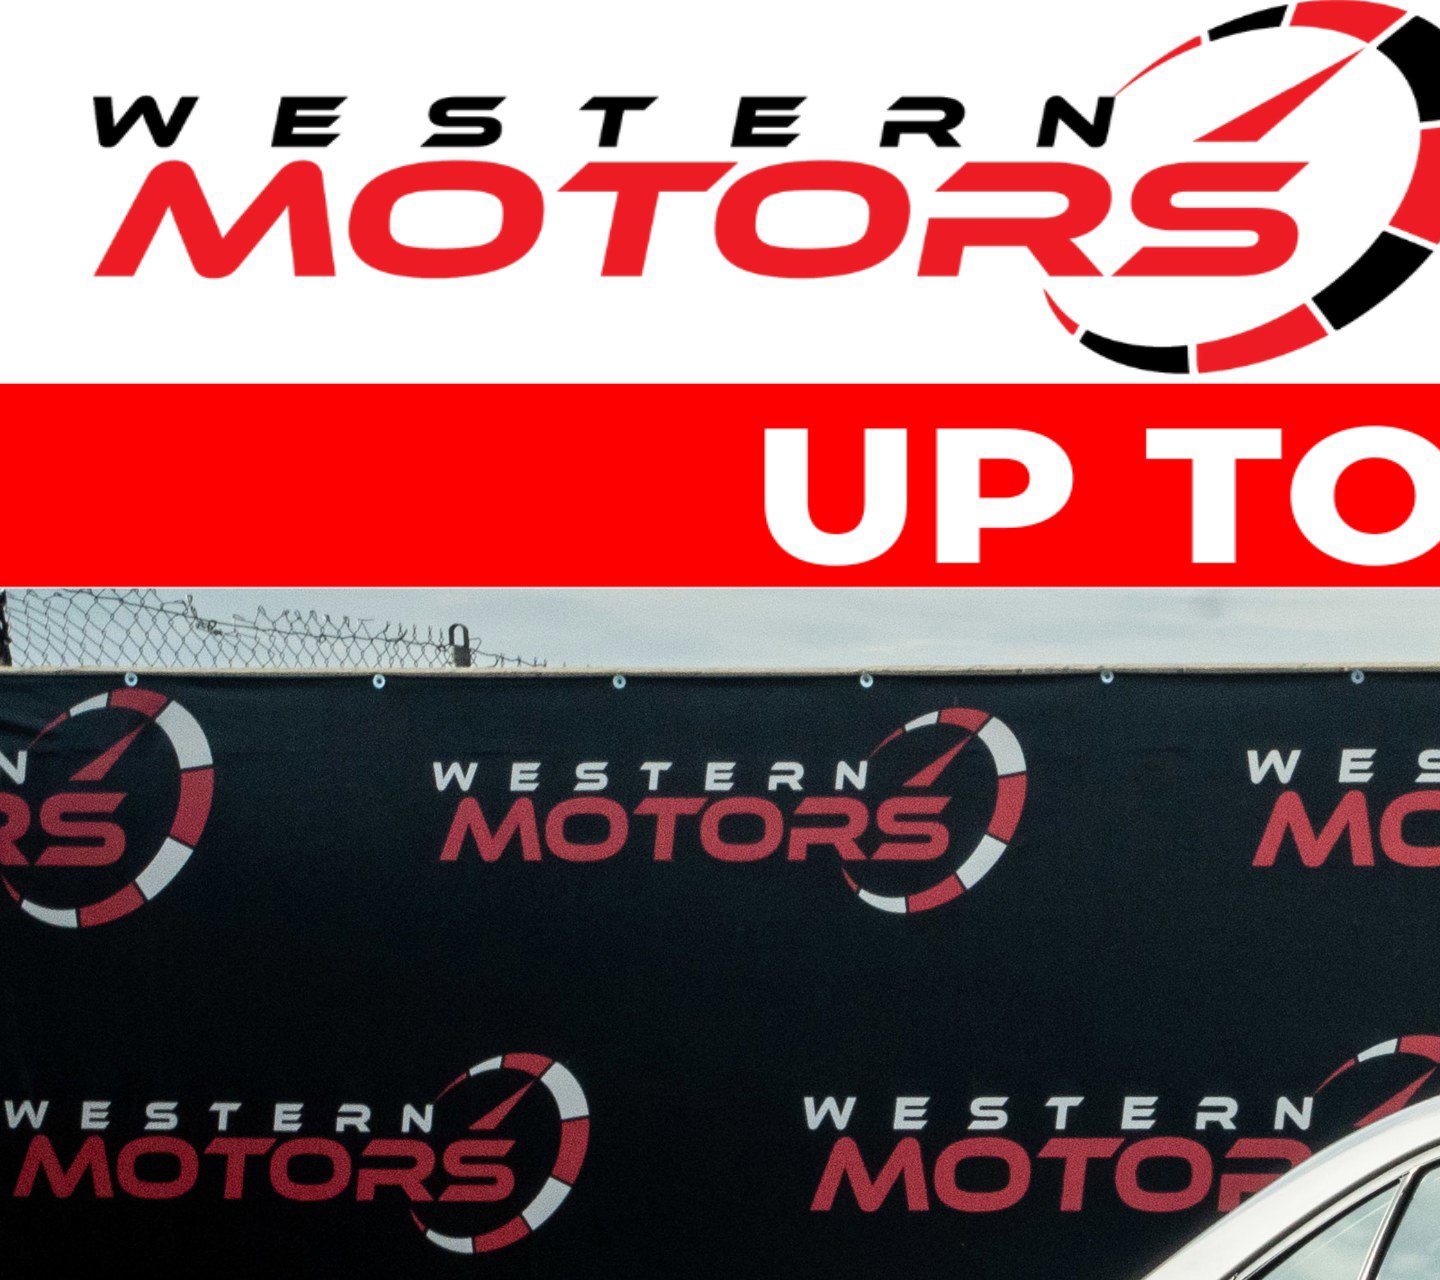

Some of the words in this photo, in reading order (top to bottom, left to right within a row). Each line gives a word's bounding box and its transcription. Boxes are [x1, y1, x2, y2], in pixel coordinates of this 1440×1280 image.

[433, 761, 867, 791] WESTERN
[440, 796, 952, 862] MOTORS
[5, 1101, 433, 1132] WESTERN
[804, 1097, 1313, 1130] WESTERN
[13, 1135, 517, 1200] MOTORS
[810, 1137, 1313, 1213] MOTOR
